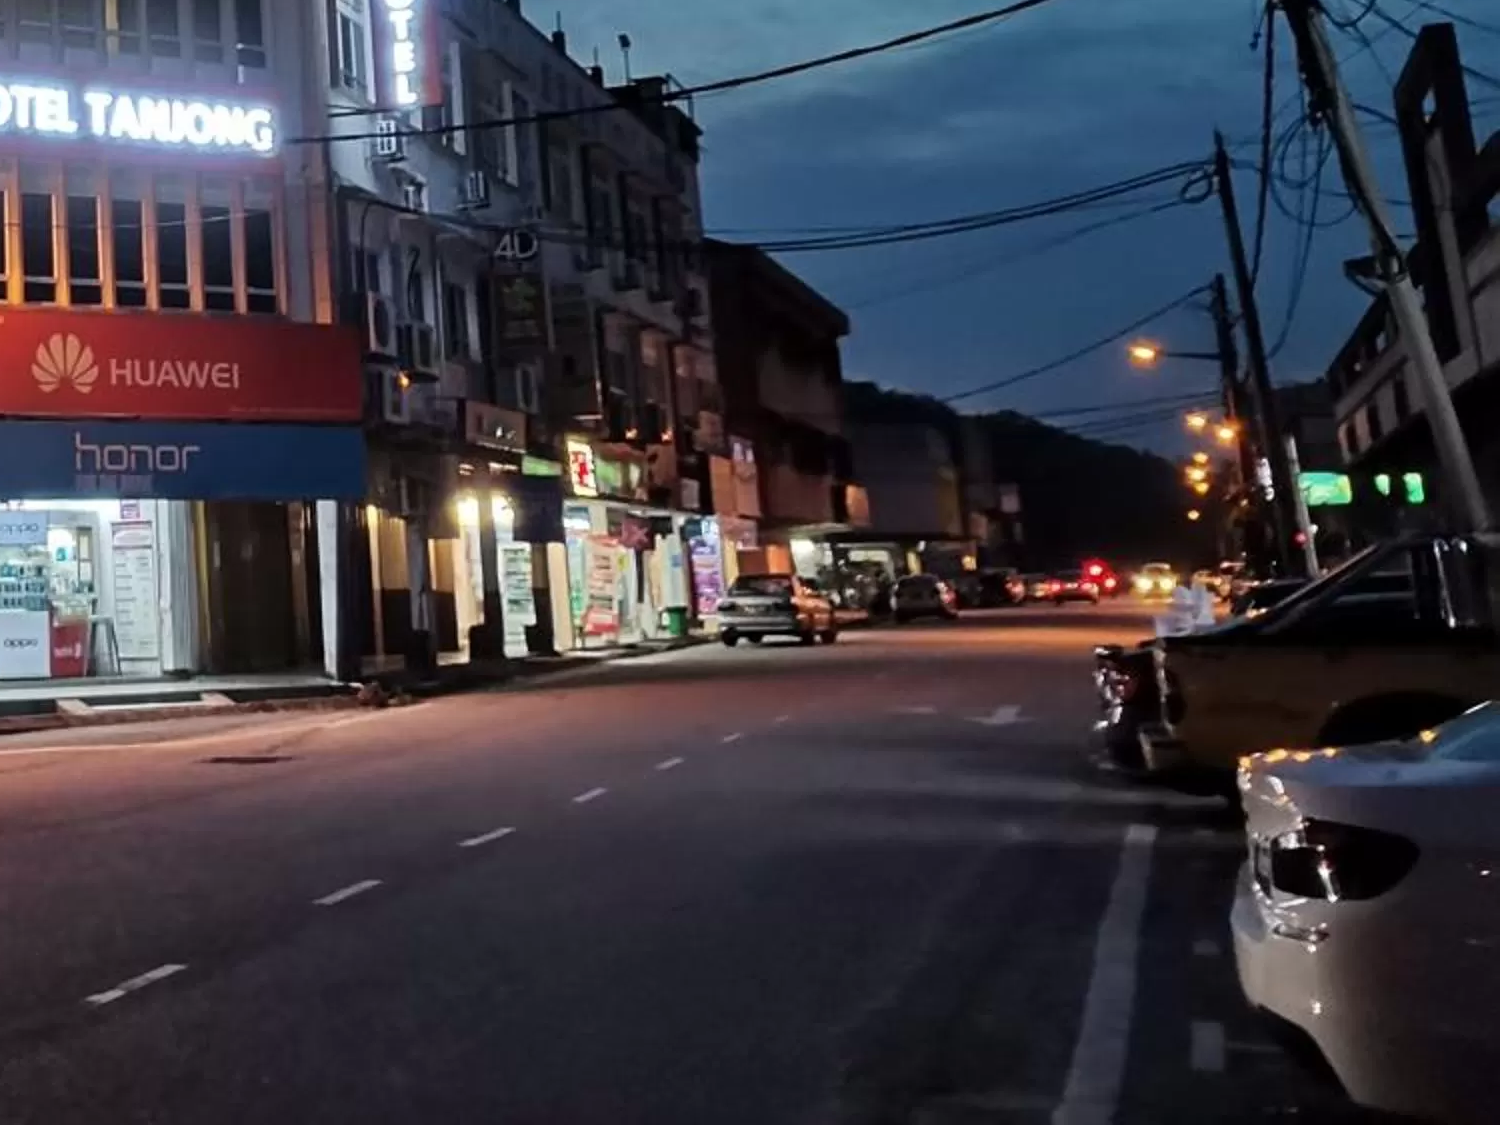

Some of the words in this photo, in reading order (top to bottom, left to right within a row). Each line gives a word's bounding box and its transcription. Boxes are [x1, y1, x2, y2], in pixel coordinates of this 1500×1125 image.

[84, 91, 274, 152] TANJONG
[493, 230, 538, 259] 4D
[109, 358, 240, 390] HUAWEI
[74, 431, 200, 474] honor
